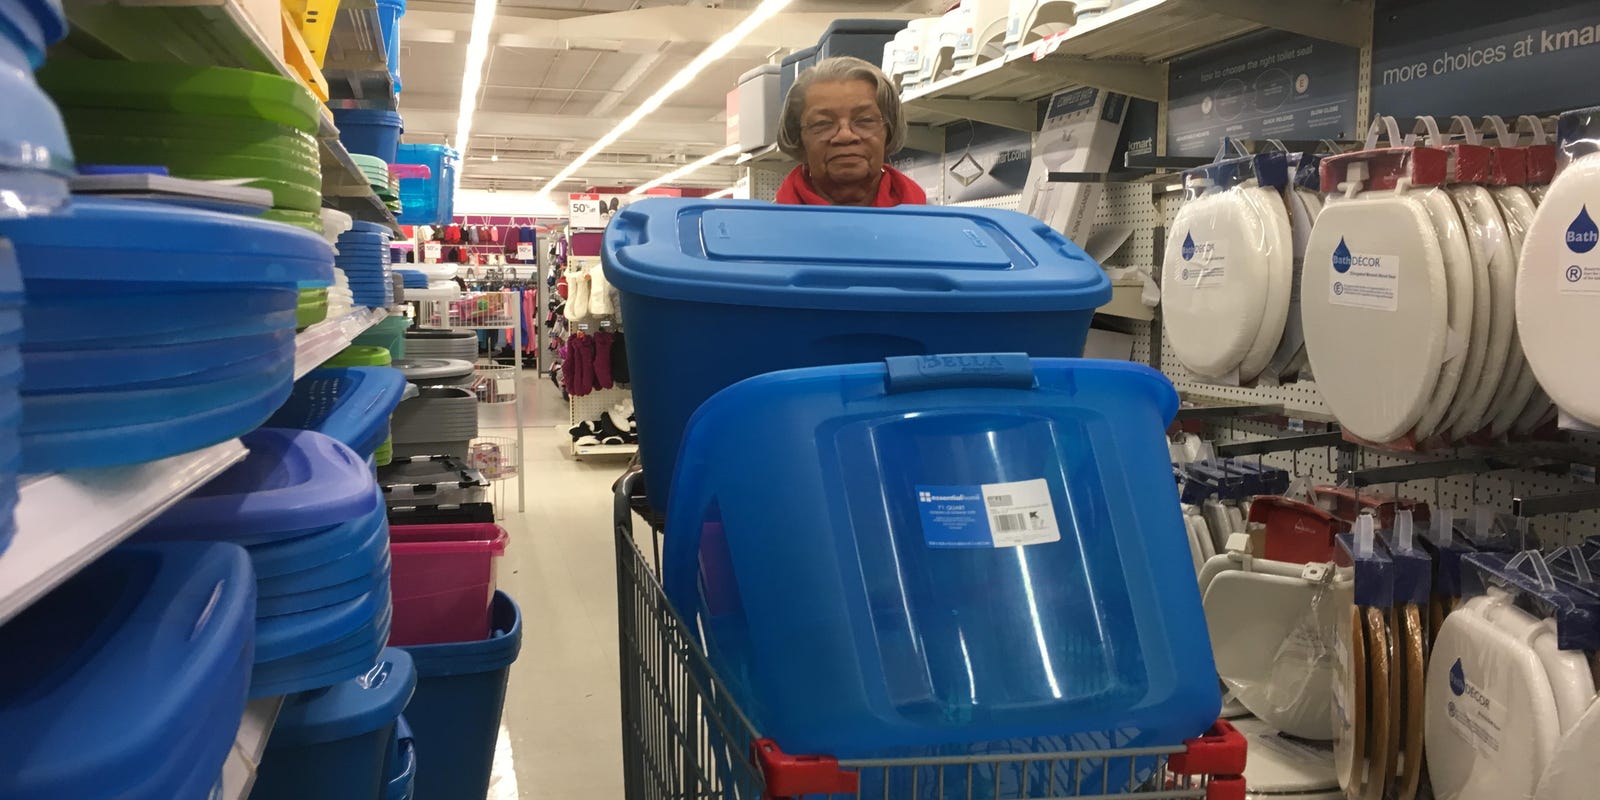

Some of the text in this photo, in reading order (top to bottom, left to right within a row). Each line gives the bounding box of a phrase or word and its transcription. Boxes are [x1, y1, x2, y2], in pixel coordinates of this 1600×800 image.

[1222, 63, 1246, 76] choose
[1247, 60, 1258, 70] the
[1259, 55, 1276, 68] right
[1277, 48, 1295, 62] toilet
[1296, 44, 1313, 57] seat
[1383, 61, 1428, 85] more
[1432, 44, 1506, 76] choices
[1513, 34, 1534, 59] at
[1567, 230, 1598, 242] Bath
